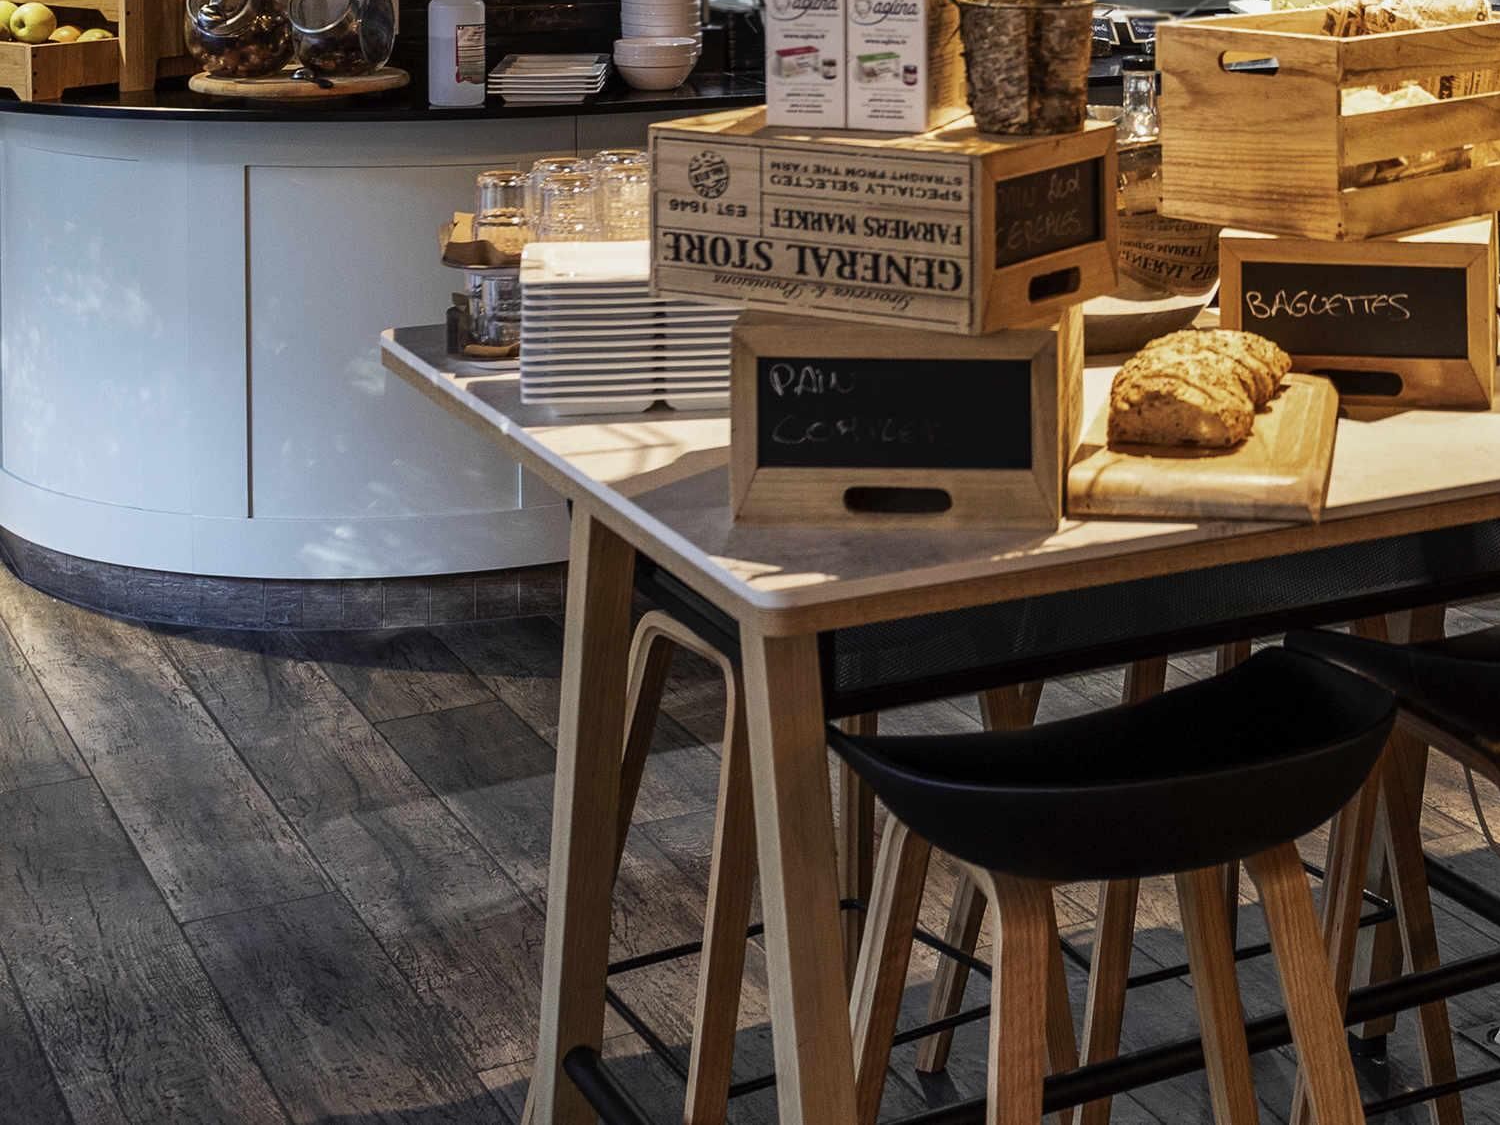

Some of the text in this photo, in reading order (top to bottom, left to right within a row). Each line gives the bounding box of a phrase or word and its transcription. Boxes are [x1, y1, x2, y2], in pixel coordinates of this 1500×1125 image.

[813, 162, 840, 176] THE
[845, 166, 886, 181] FROM
[889, 169, 963, 187] STRAIGHT
[770, 174, 963, 202] SPECIALLY SELECTED
[669, 198, 748, 218] EST 1846
[769, 207, 963, 246] FARMERS MARKET
[661, 231, 964, 293] GENERAL STORE
[711, 272, 808, 300] Provisions
[832, 285, 916, 312] Groceries
[1246, 289, 1412, 320] BAGUETTES
